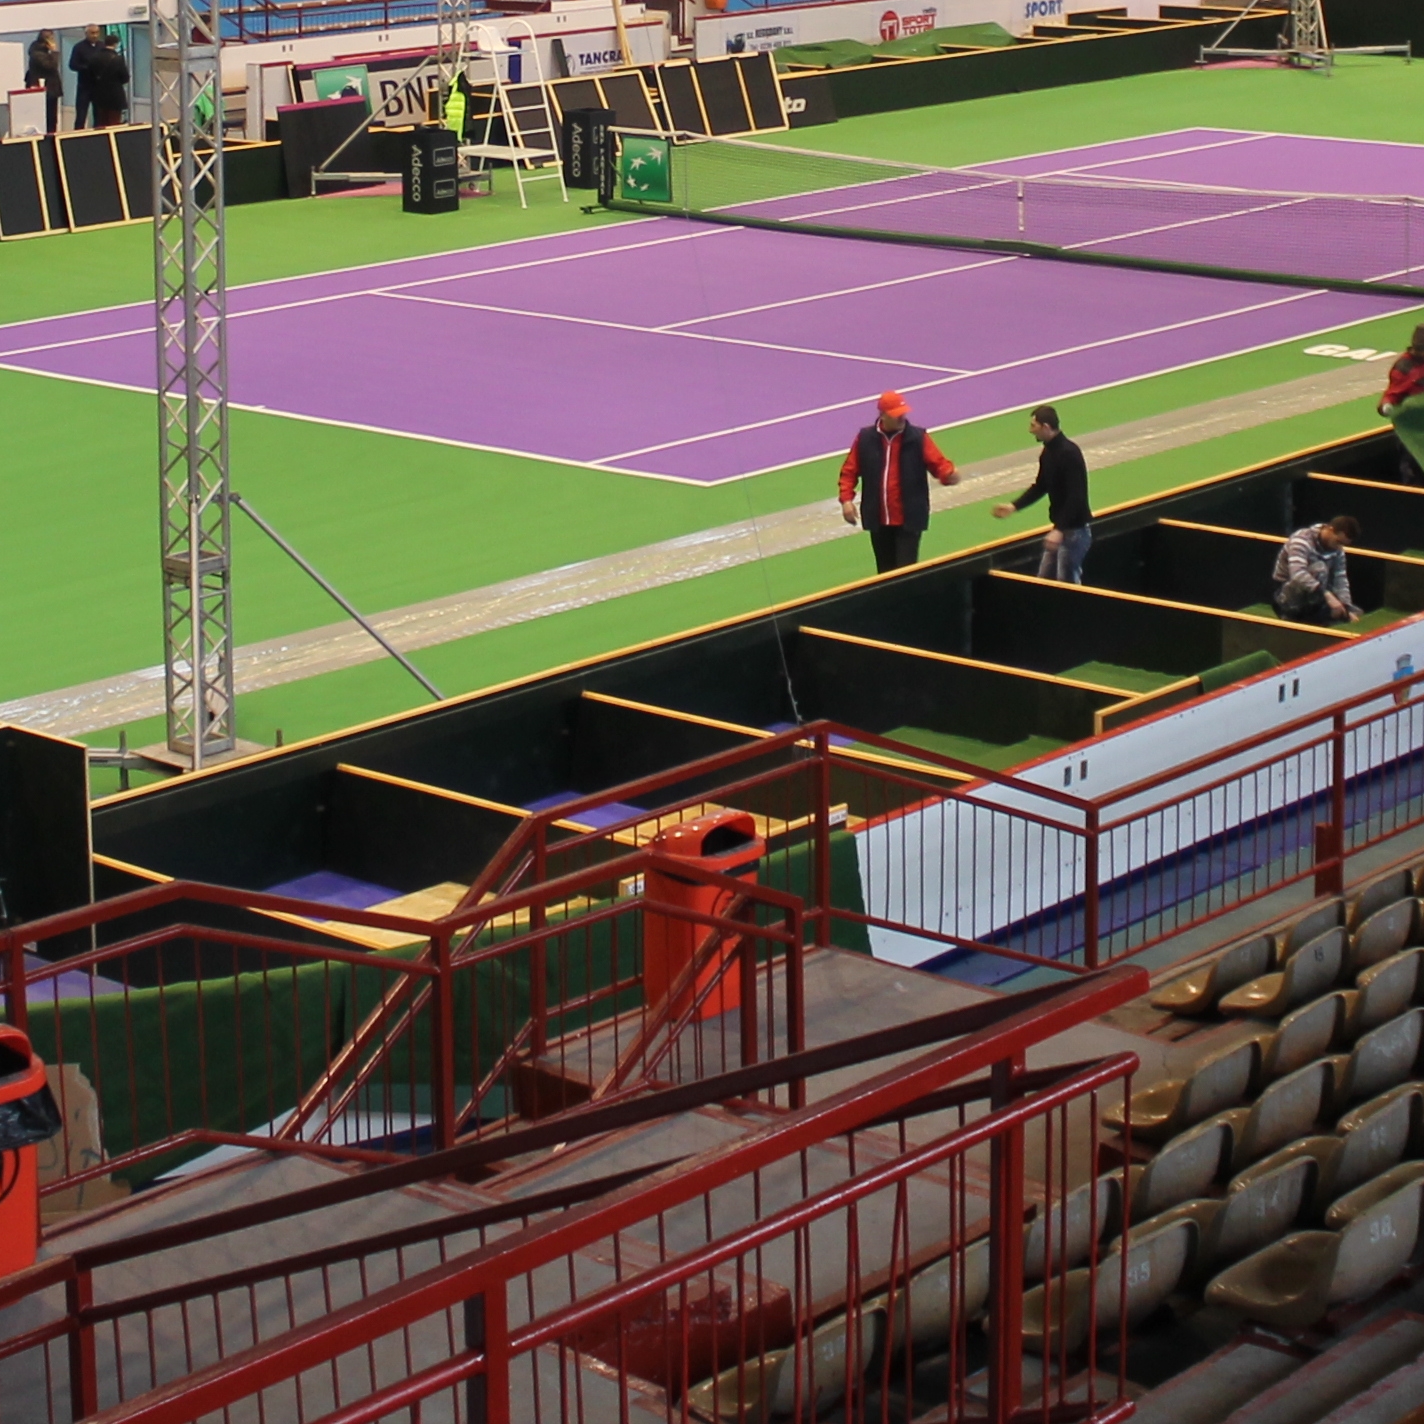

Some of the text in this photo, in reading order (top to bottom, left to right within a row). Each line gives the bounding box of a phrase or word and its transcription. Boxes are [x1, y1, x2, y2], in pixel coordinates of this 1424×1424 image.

[1026, 0, 1063, 18] SPORT
[902, 14, 937, 28] SPORT
[579, 50, 633, 66] TANCRA
[571, 122, 583, 178] Adecco
[411, 144, 423, 202] Adecco
